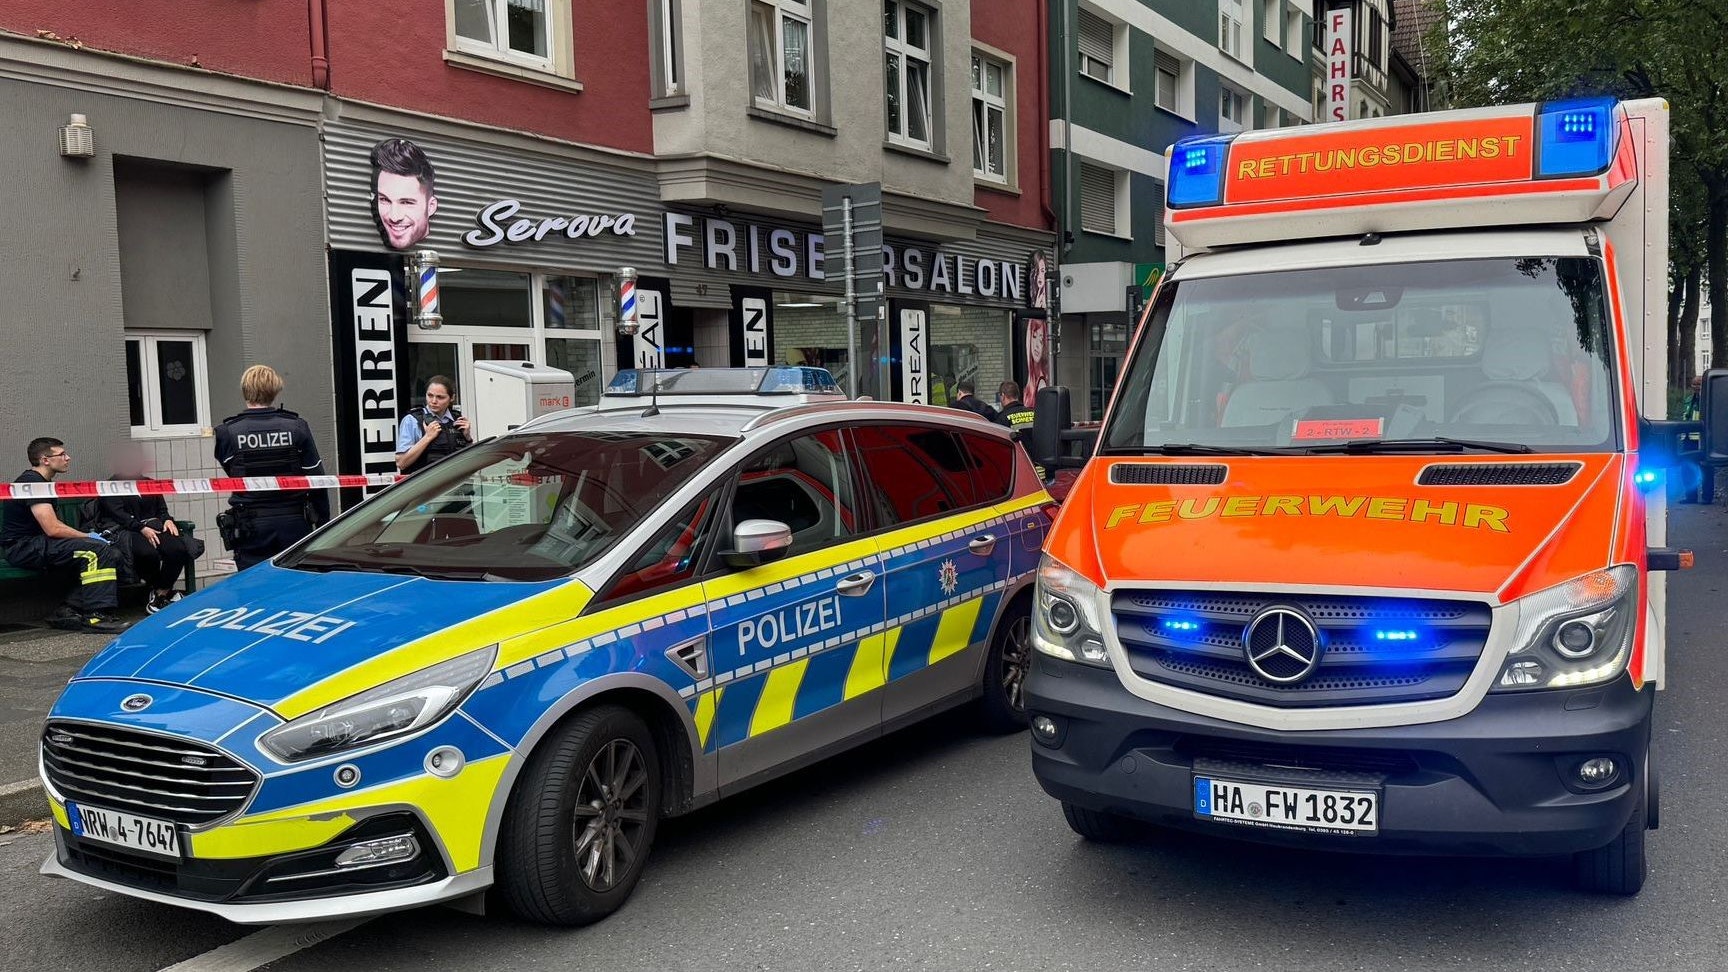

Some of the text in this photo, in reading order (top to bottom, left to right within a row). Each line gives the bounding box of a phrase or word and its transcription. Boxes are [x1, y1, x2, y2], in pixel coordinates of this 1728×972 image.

[1331, 14, 1346, 122] FAHRS
[1237, 135, 1521, 181] RETTUNGSDIENST
[464, 199, 636, 247] Serova
[664, 212, 1021, 299] FRISERSALON
[540, 396, 561, 407] mark
[237, 431, 293, 449] POLIZEI
[1324, 427, 1351, 436] RTW
[1103, 494, 1511, 534] FEUERWEHR
[166, 606, 358, 645] POLIZEI
[737, 595, 843, 657] POLIZEI
[1213, 784, 1245, 815] HA
[1265, 789, 1299, 820] FW
[1305, 794, 1373, 826] 1832
[80, 808, 109, 838] NRW
[118, 815, 175, 852] 4-7647
